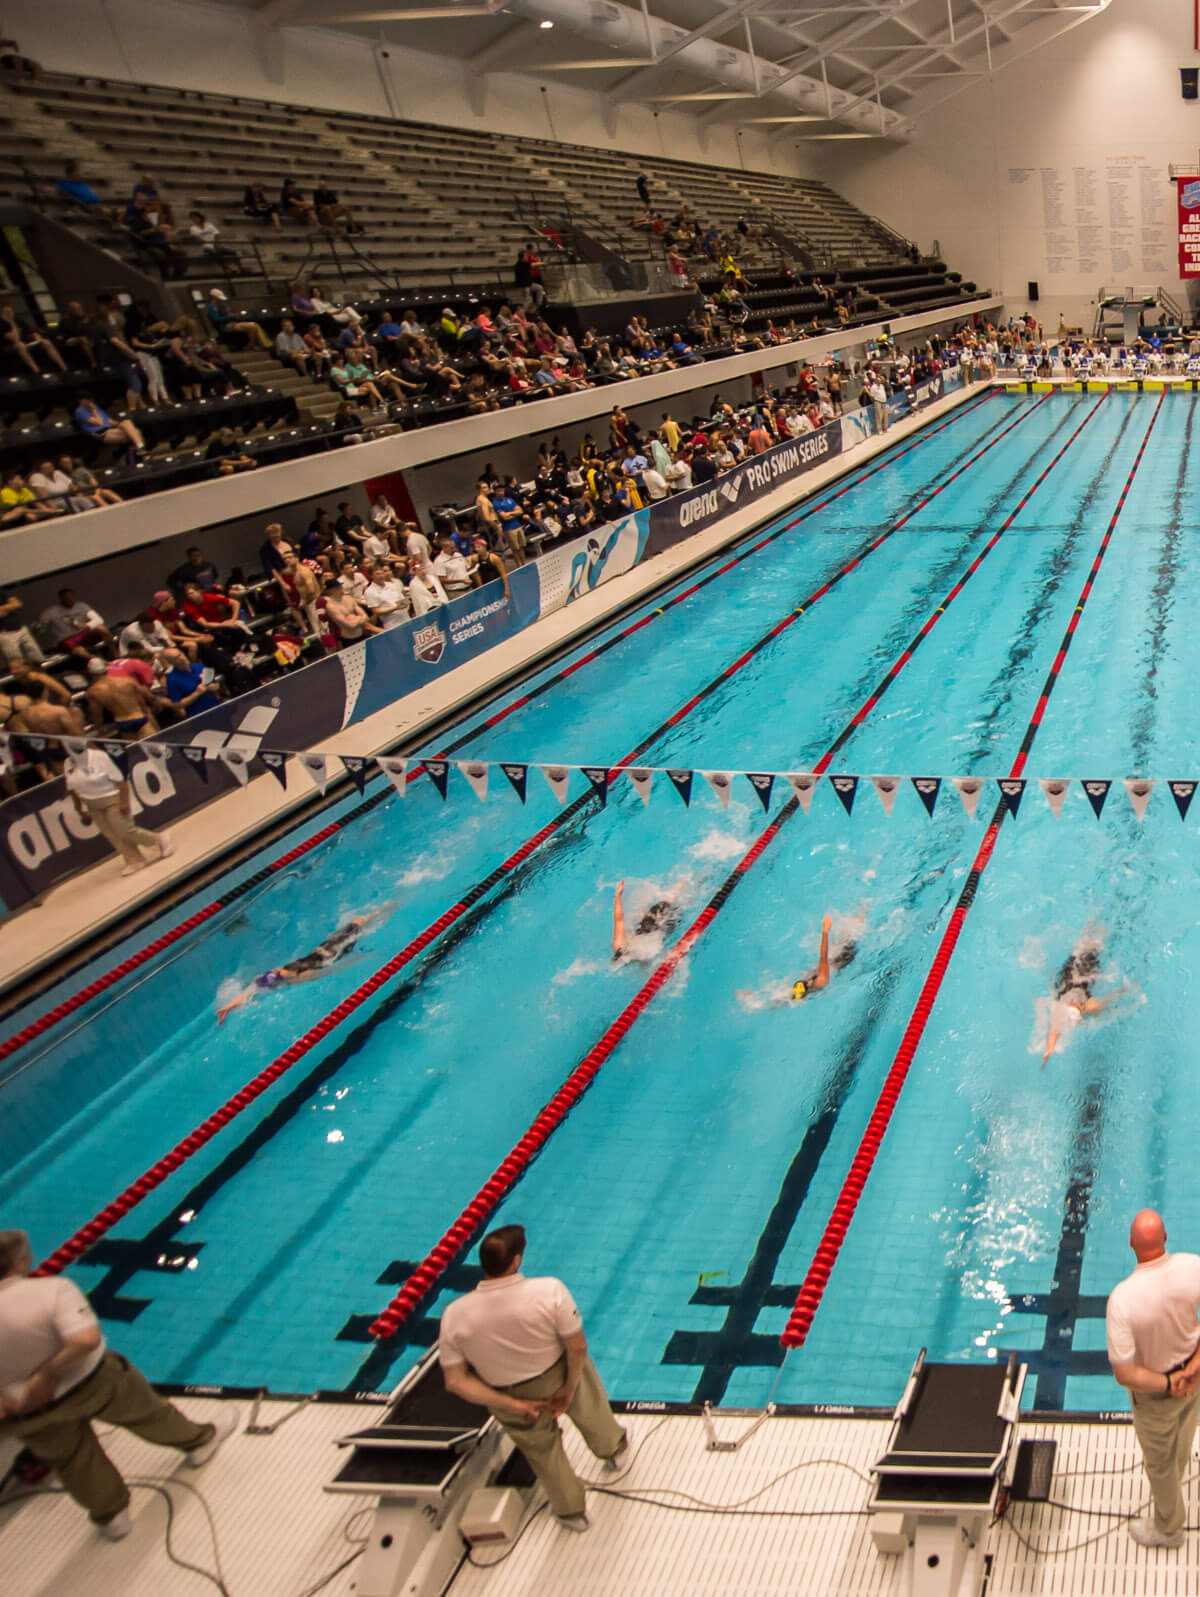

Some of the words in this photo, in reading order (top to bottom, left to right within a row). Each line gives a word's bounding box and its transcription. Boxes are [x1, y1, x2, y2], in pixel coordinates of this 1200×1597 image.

[680, 489, 718, 527] arena
[746, 460, 771, 490] PRO
[772, 447, 799, 477] SWIM
[800, 433, 829, 463] SERIES
[418, 628, 438, 645] USA
[452, 622, 484, 645] SERIES
